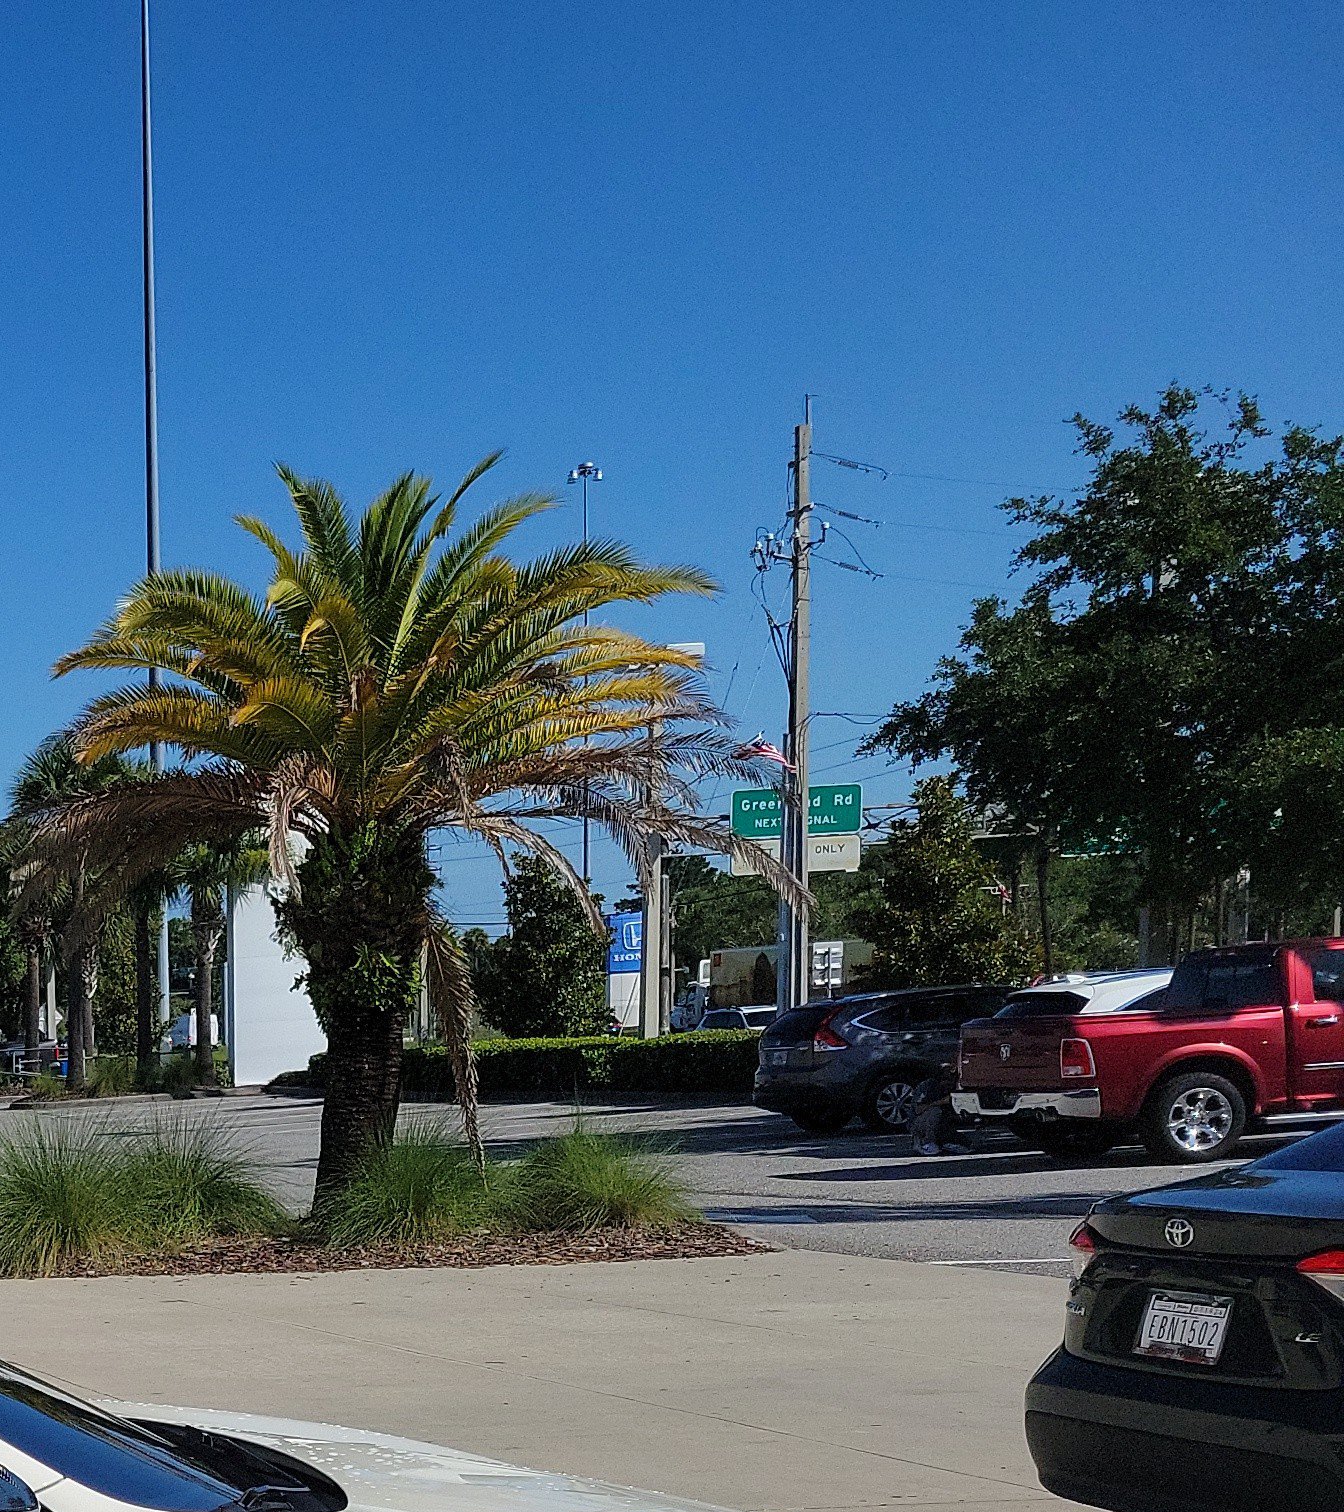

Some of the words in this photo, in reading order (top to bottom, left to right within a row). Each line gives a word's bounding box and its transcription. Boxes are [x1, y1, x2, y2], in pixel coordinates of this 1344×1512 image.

[833, 793, 853, 806] Rd
[807, 815, 838, 825] GNAL
[815, 844, 845, 854] ONLY
[1148, 1314, 1219, 1347] EBN1502
